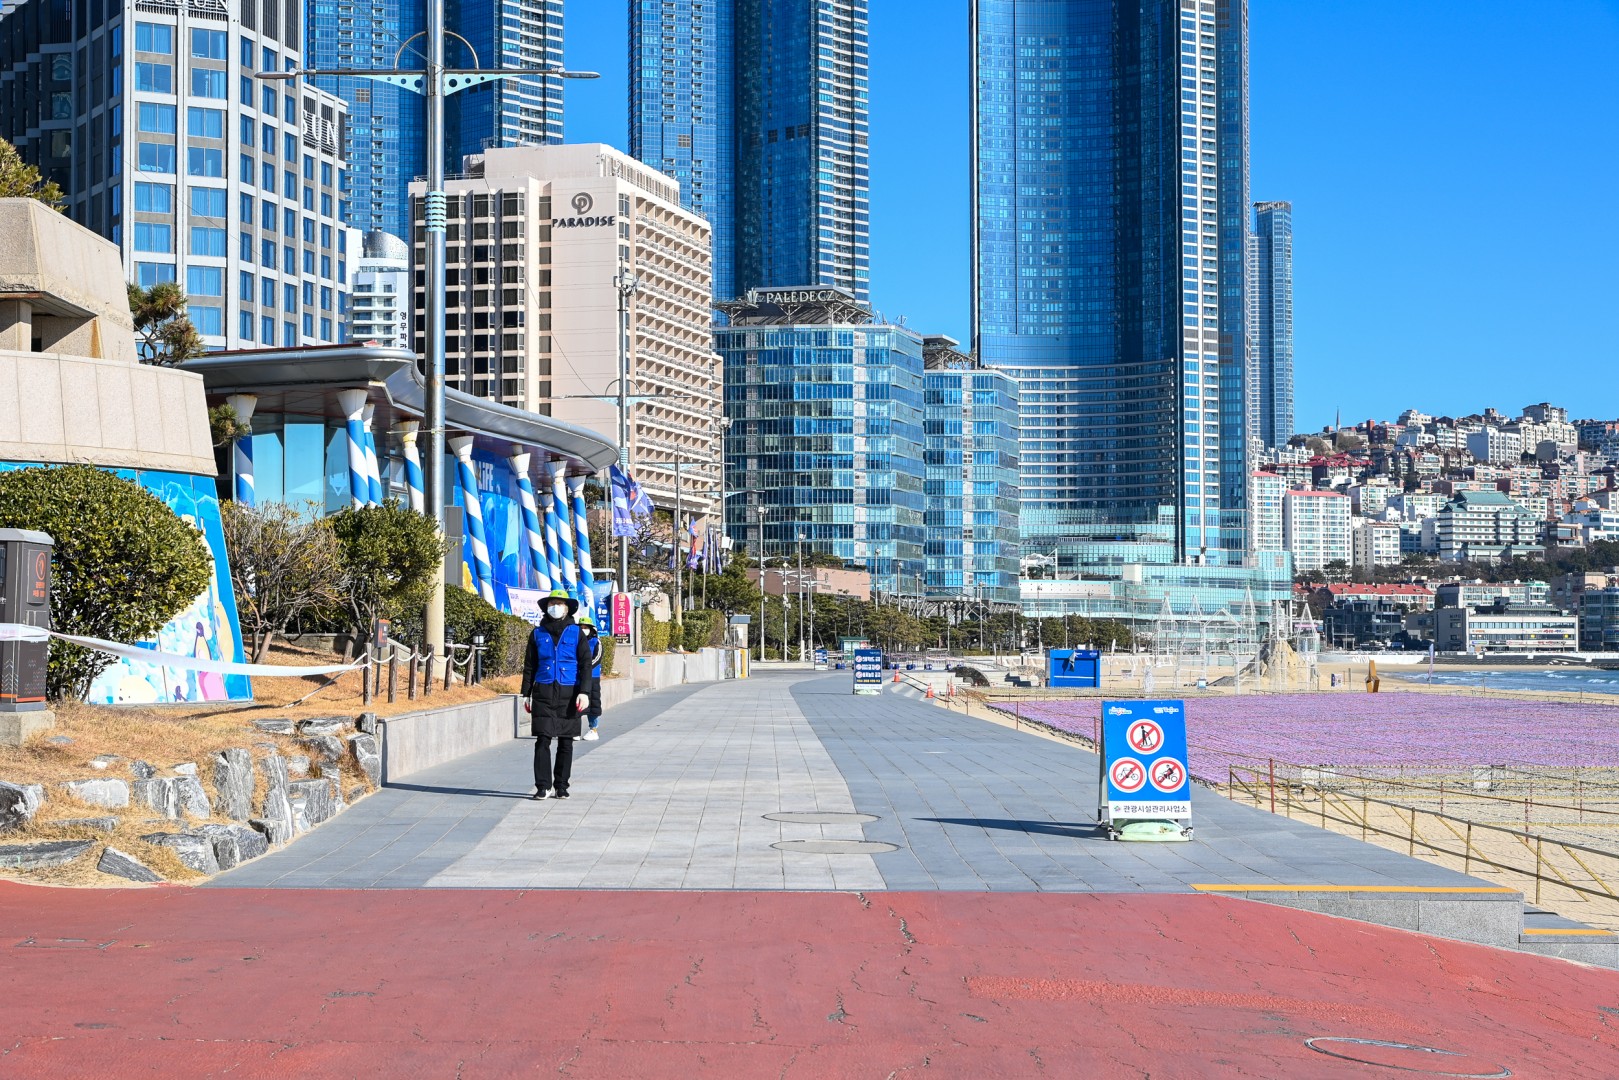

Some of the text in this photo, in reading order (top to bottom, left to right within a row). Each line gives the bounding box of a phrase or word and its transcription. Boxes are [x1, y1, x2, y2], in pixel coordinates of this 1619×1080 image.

[552, 215, 616, 228] PARADISE
[766, 290, 835, 303] PALEDECZ
[618, 602, 626, 633] 롯데리아
[1123, 805, 1188, 813] 관광시설관리사업소
